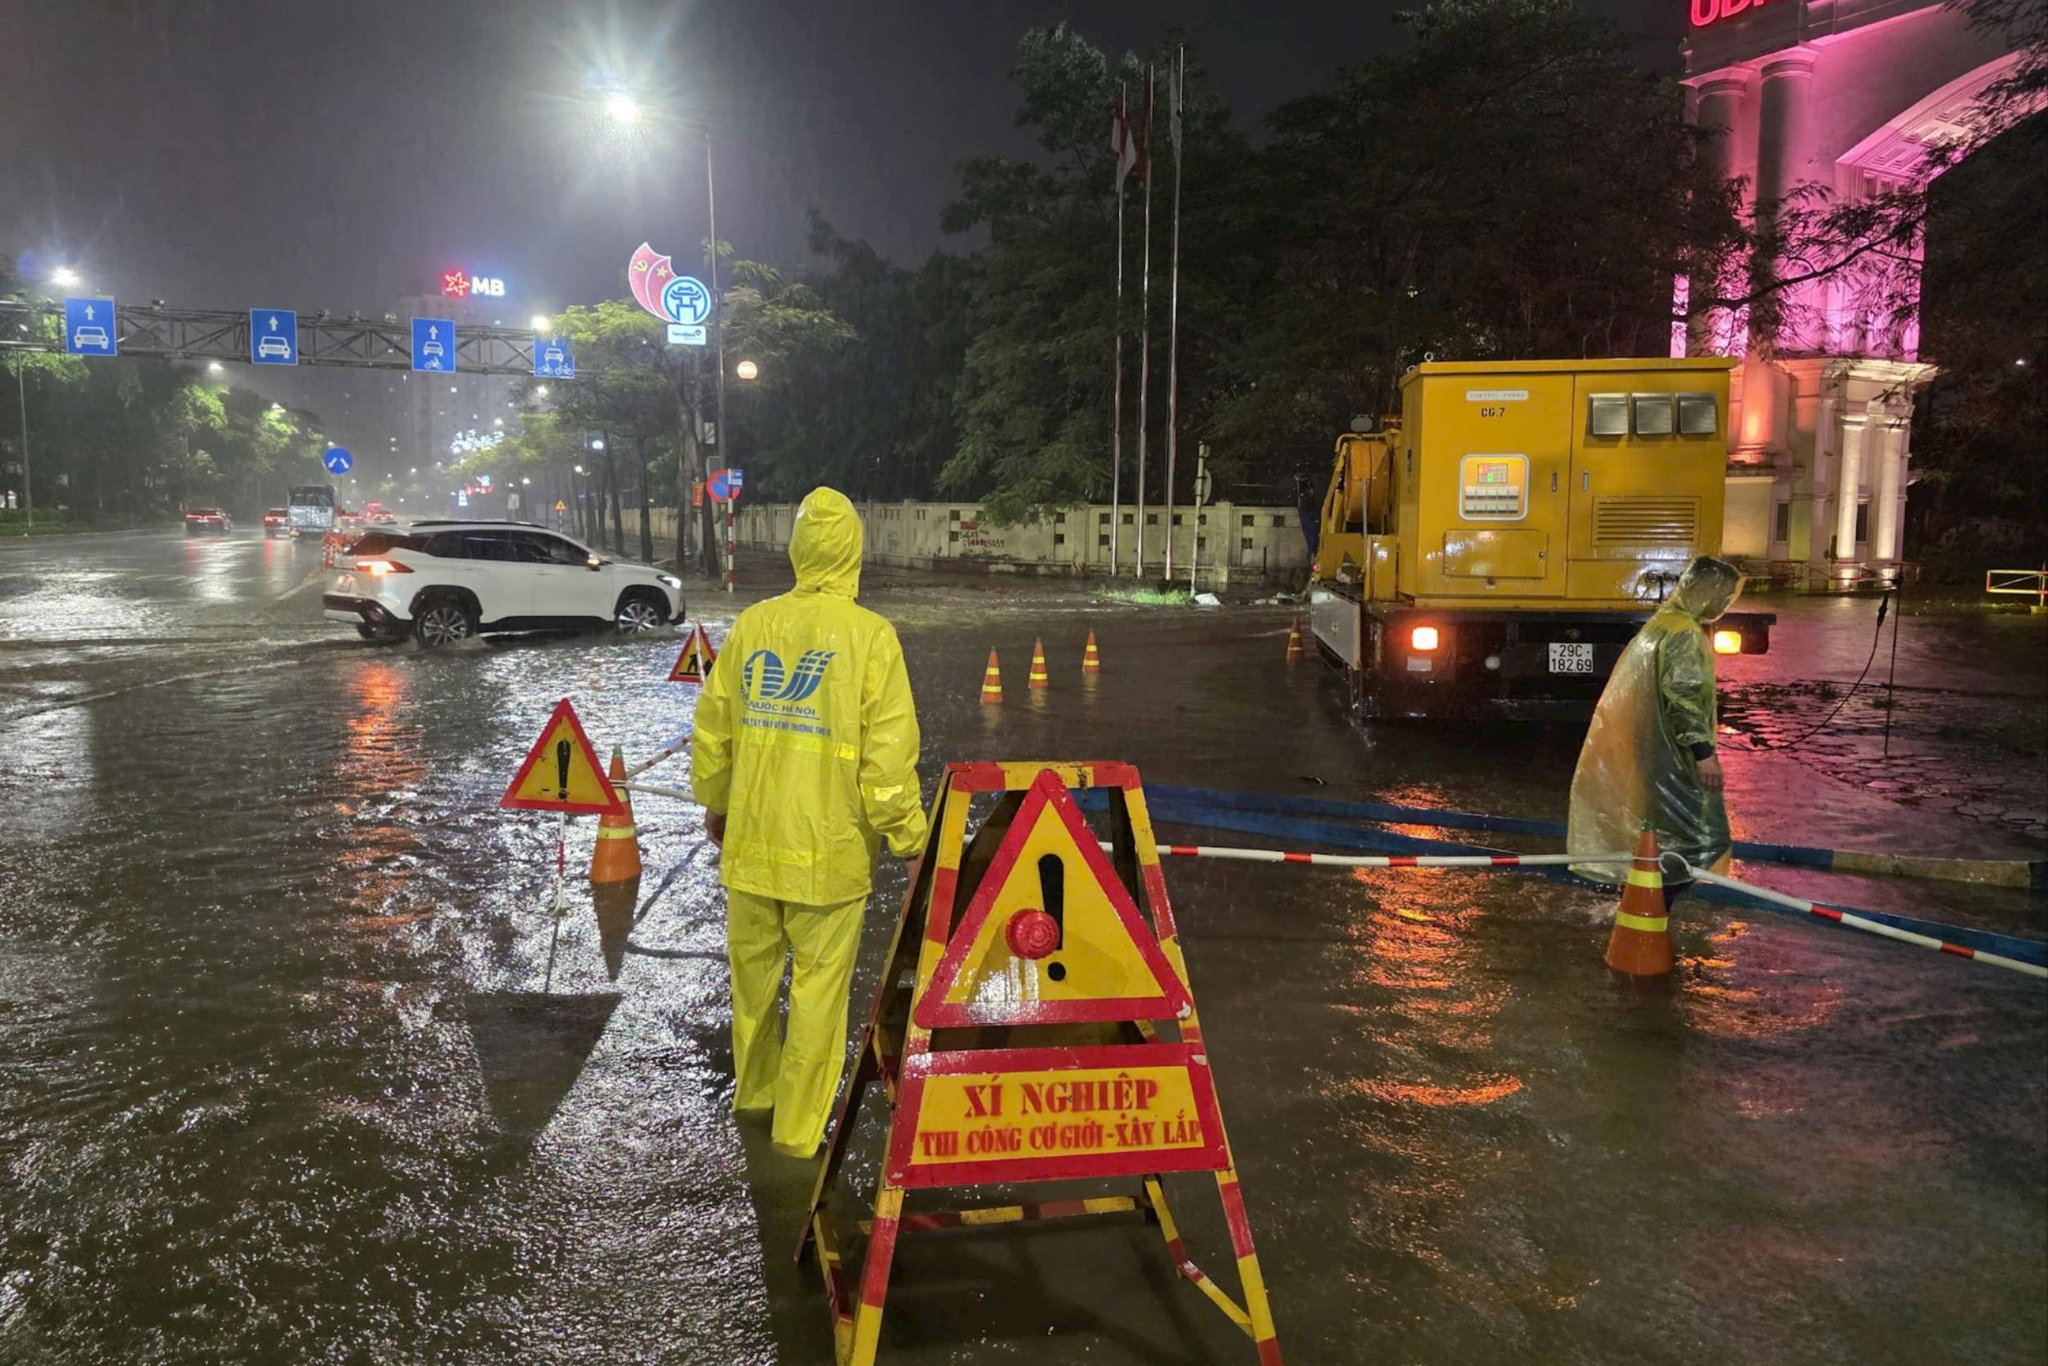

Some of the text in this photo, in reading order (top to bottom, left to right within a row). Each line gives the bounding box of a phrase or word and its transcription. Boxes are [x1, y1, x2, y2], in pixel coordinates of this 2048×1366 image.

[472, 276, 505, 296] MB
[1559, 644, 1583, 657] 29C
[963, 1072, 1158, 1120] XÍ NGHIỆP
[919, 1131, 959, 1156] THI
[967, 1124, 1022, 1154] CÔNG
[1029, 1121, 1057, 1149] CƠ
[1163, 1109, 1200, 1144] LẮP
